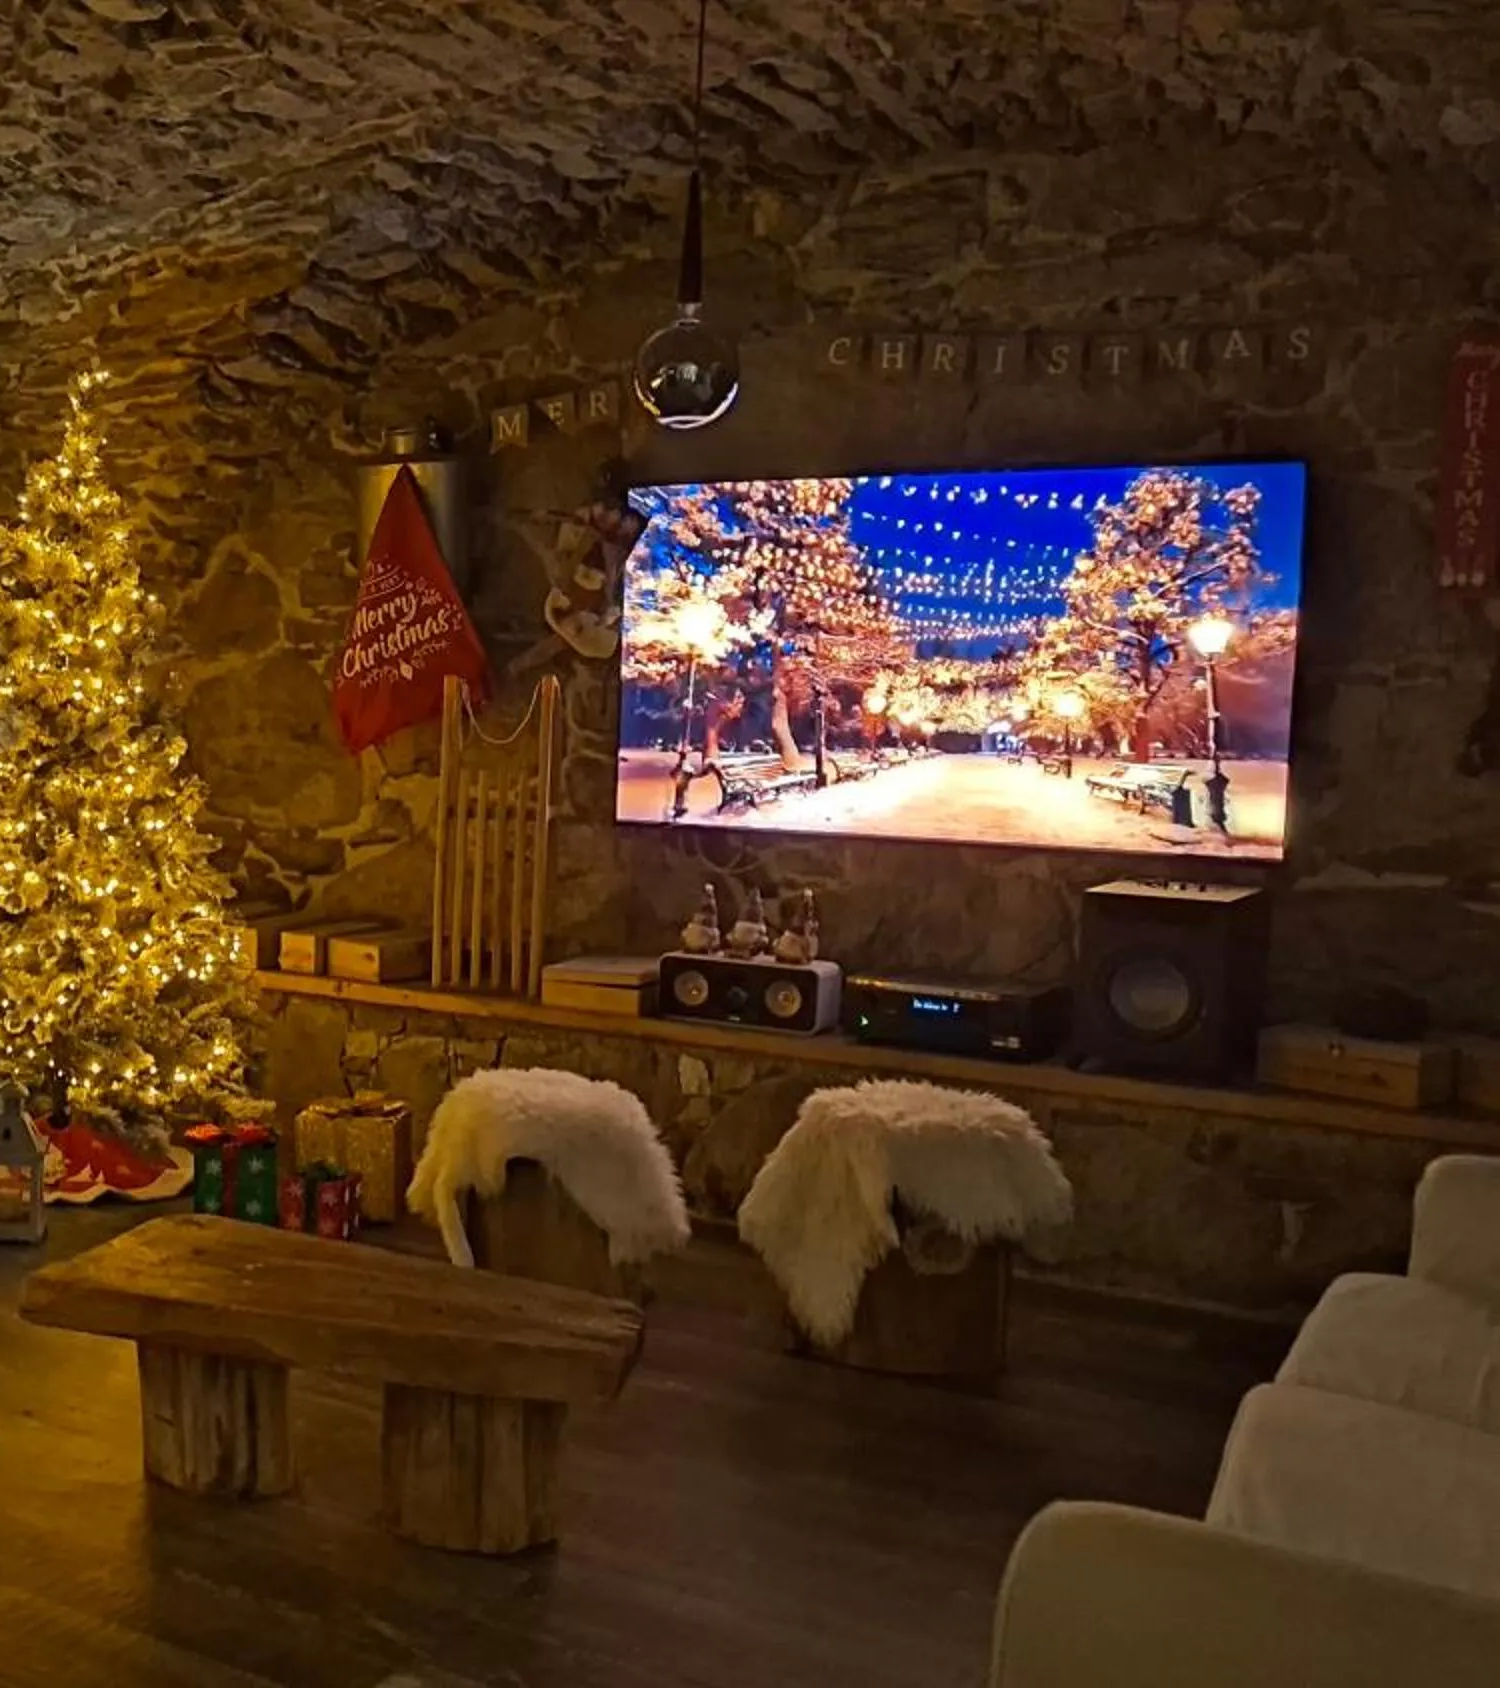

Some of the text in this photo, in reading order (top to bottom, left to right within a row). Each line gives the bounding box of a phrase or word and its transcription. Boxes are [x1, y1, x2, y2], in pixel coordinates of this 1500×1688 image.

[827, 327, 1311, 376] CHRISTMAS
[1454, 369, 1488, 547] CHRISTMAS
[343, 608, 450, 677] Christmas
[352, 592, 417, 640] Merry
